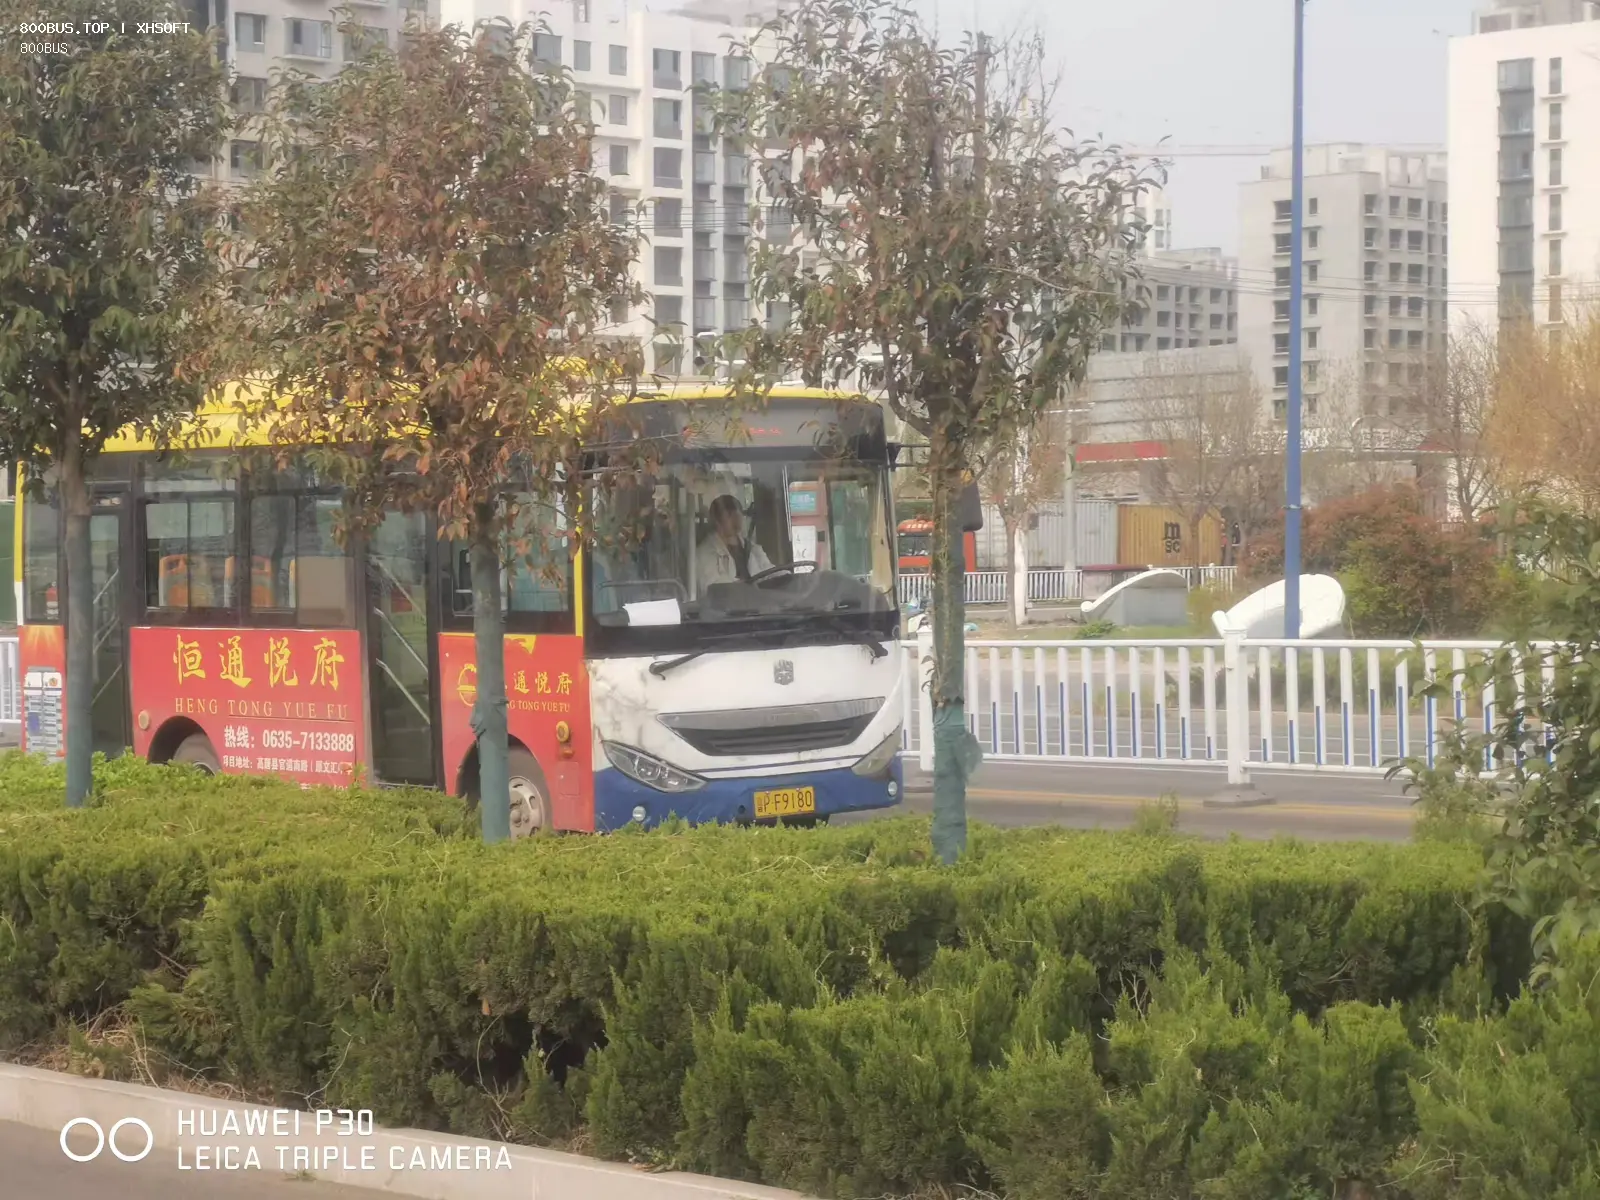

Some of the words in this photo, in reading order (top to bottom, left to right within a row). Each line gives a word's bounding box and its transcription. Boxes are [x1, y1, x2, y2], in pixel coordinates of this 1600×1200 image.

[173, 634, 345, 691] 恒通悦府
[504, 670, 573, 696] 通悦府
[175, 697, 218, 714] HENG
[228, 699, 273, 717] TONG
[283, 702, 317, 718] YUE
[327, 704, 348, 719] FU
[518, 701, 540, 711] TONG
[541, 702, 558, 712] YUE
